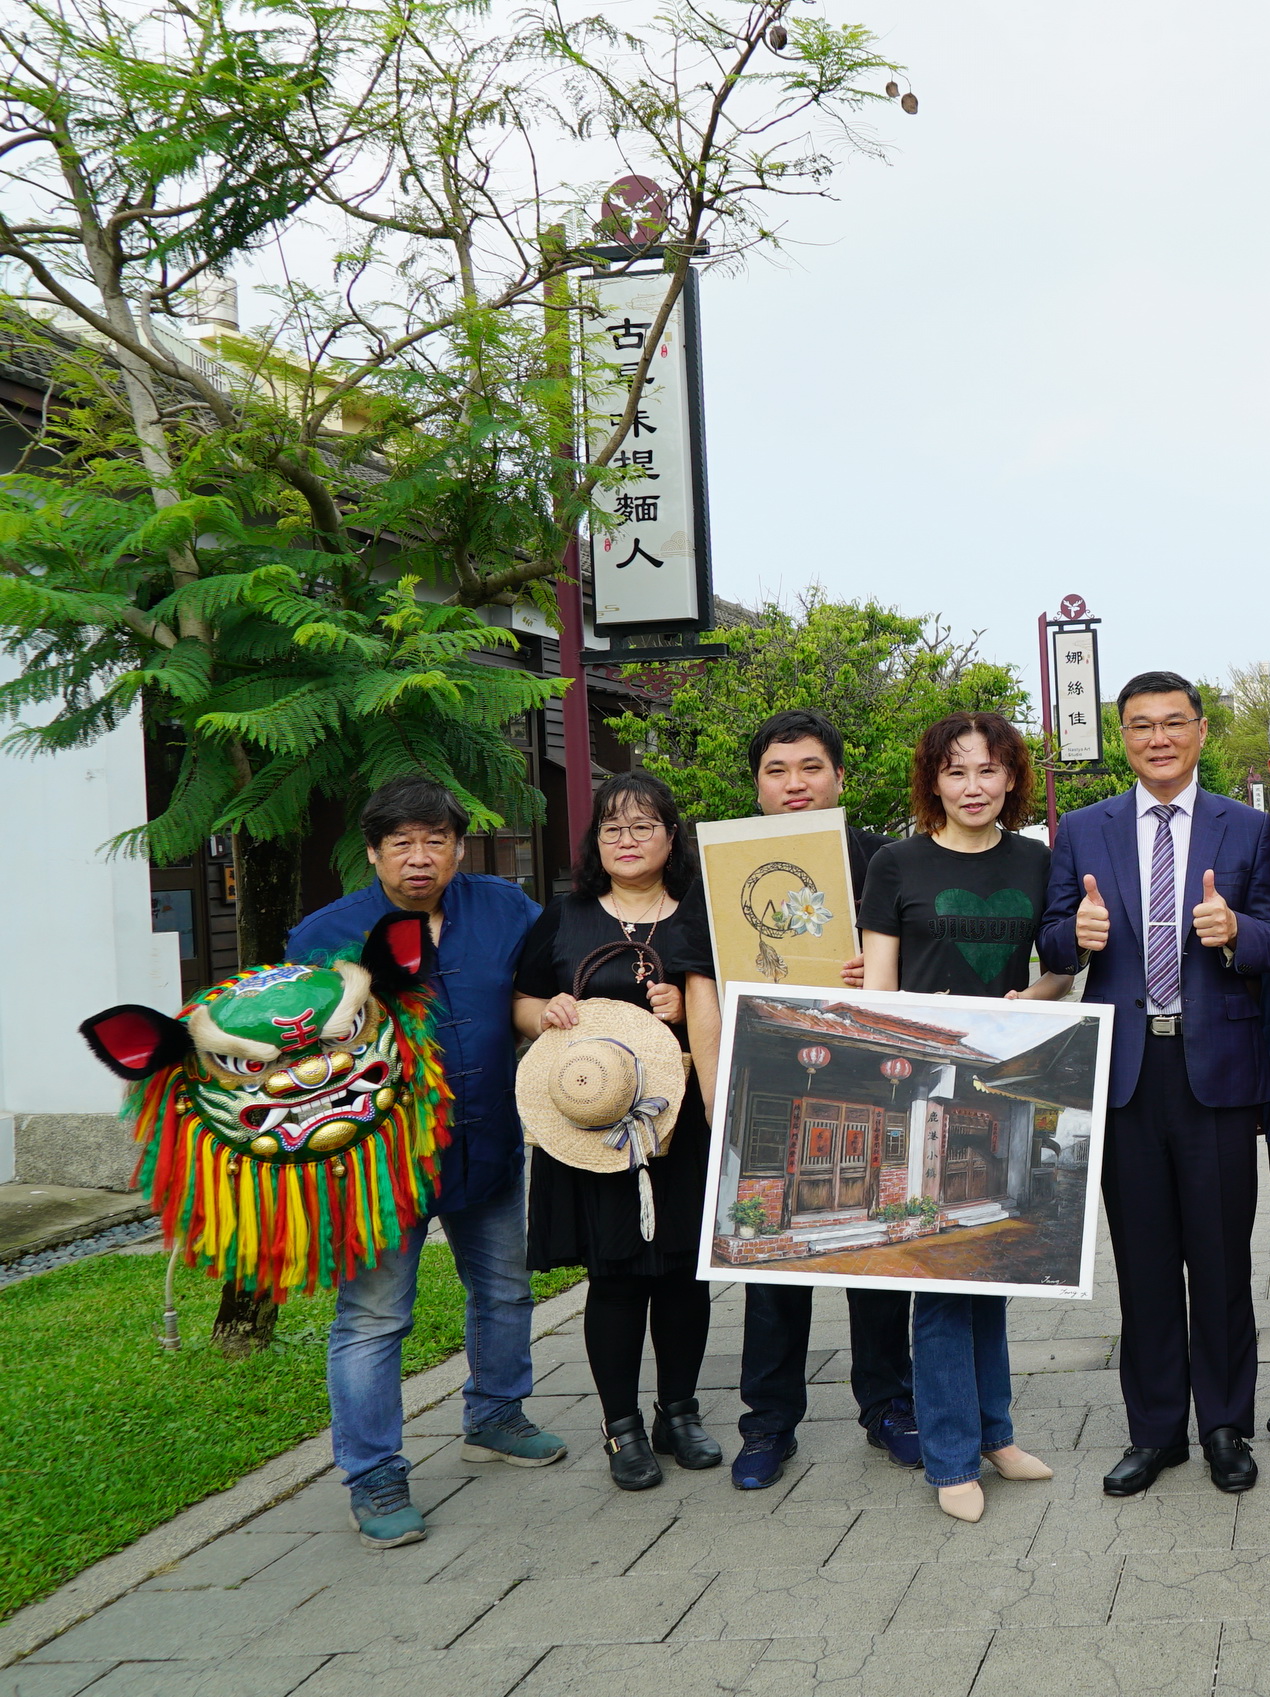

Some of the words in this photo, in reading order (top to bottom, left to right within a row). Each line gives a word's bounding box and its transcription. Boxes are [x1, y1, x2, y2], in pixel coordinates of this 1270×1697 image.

[1065, 651, 1087, 727] 娜絲佳
[272, 1007, 319, 1052] 王
[925, 1111, 939, 1179] 鹿港小鎮
